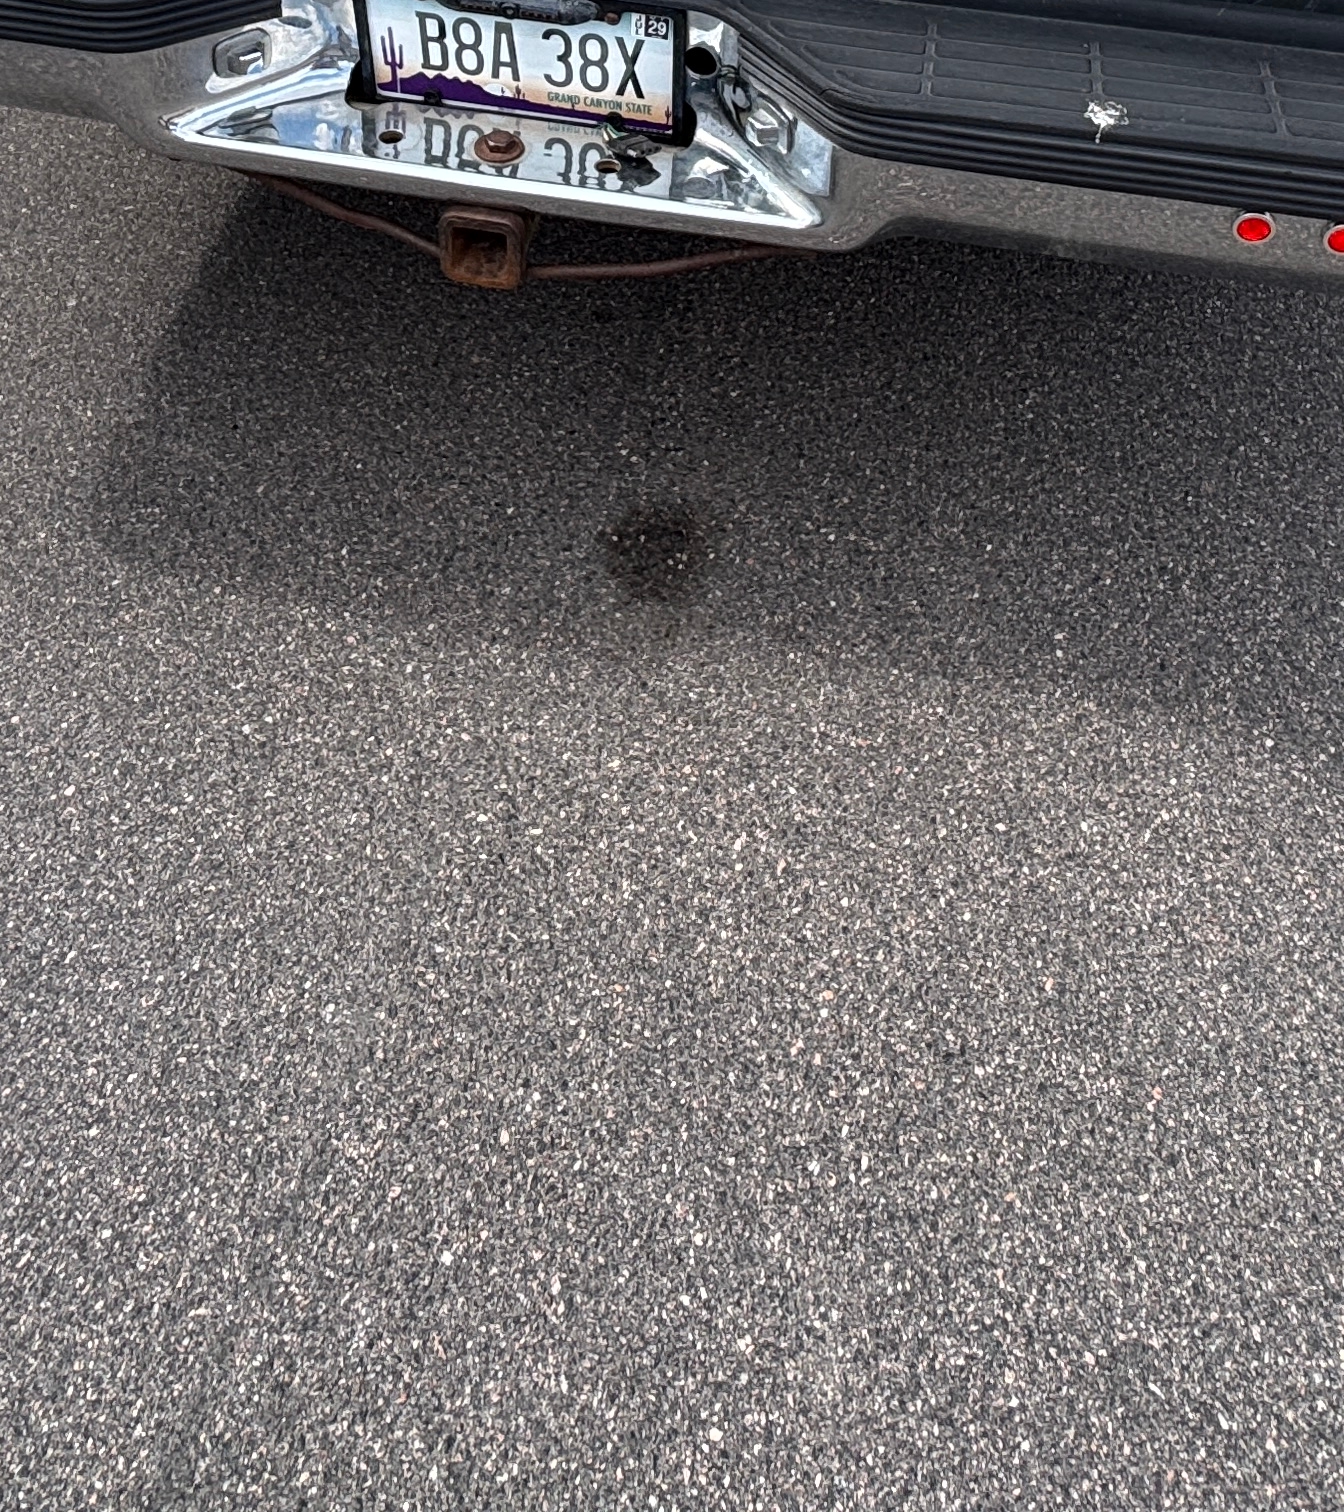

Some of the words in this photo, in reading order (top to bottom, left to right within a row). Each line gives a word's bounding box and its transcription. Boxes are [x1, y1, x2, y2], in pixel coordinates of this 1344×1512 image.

[648, 20, 666, 36] 29
[415, 10, 520, 82] B8A
[541, 28, 645, 99] 38X
[547, 91, 580, 105] GRAND
[583, 96, 622, 111] CANYON
[625, 102, 653, 116] STATE
